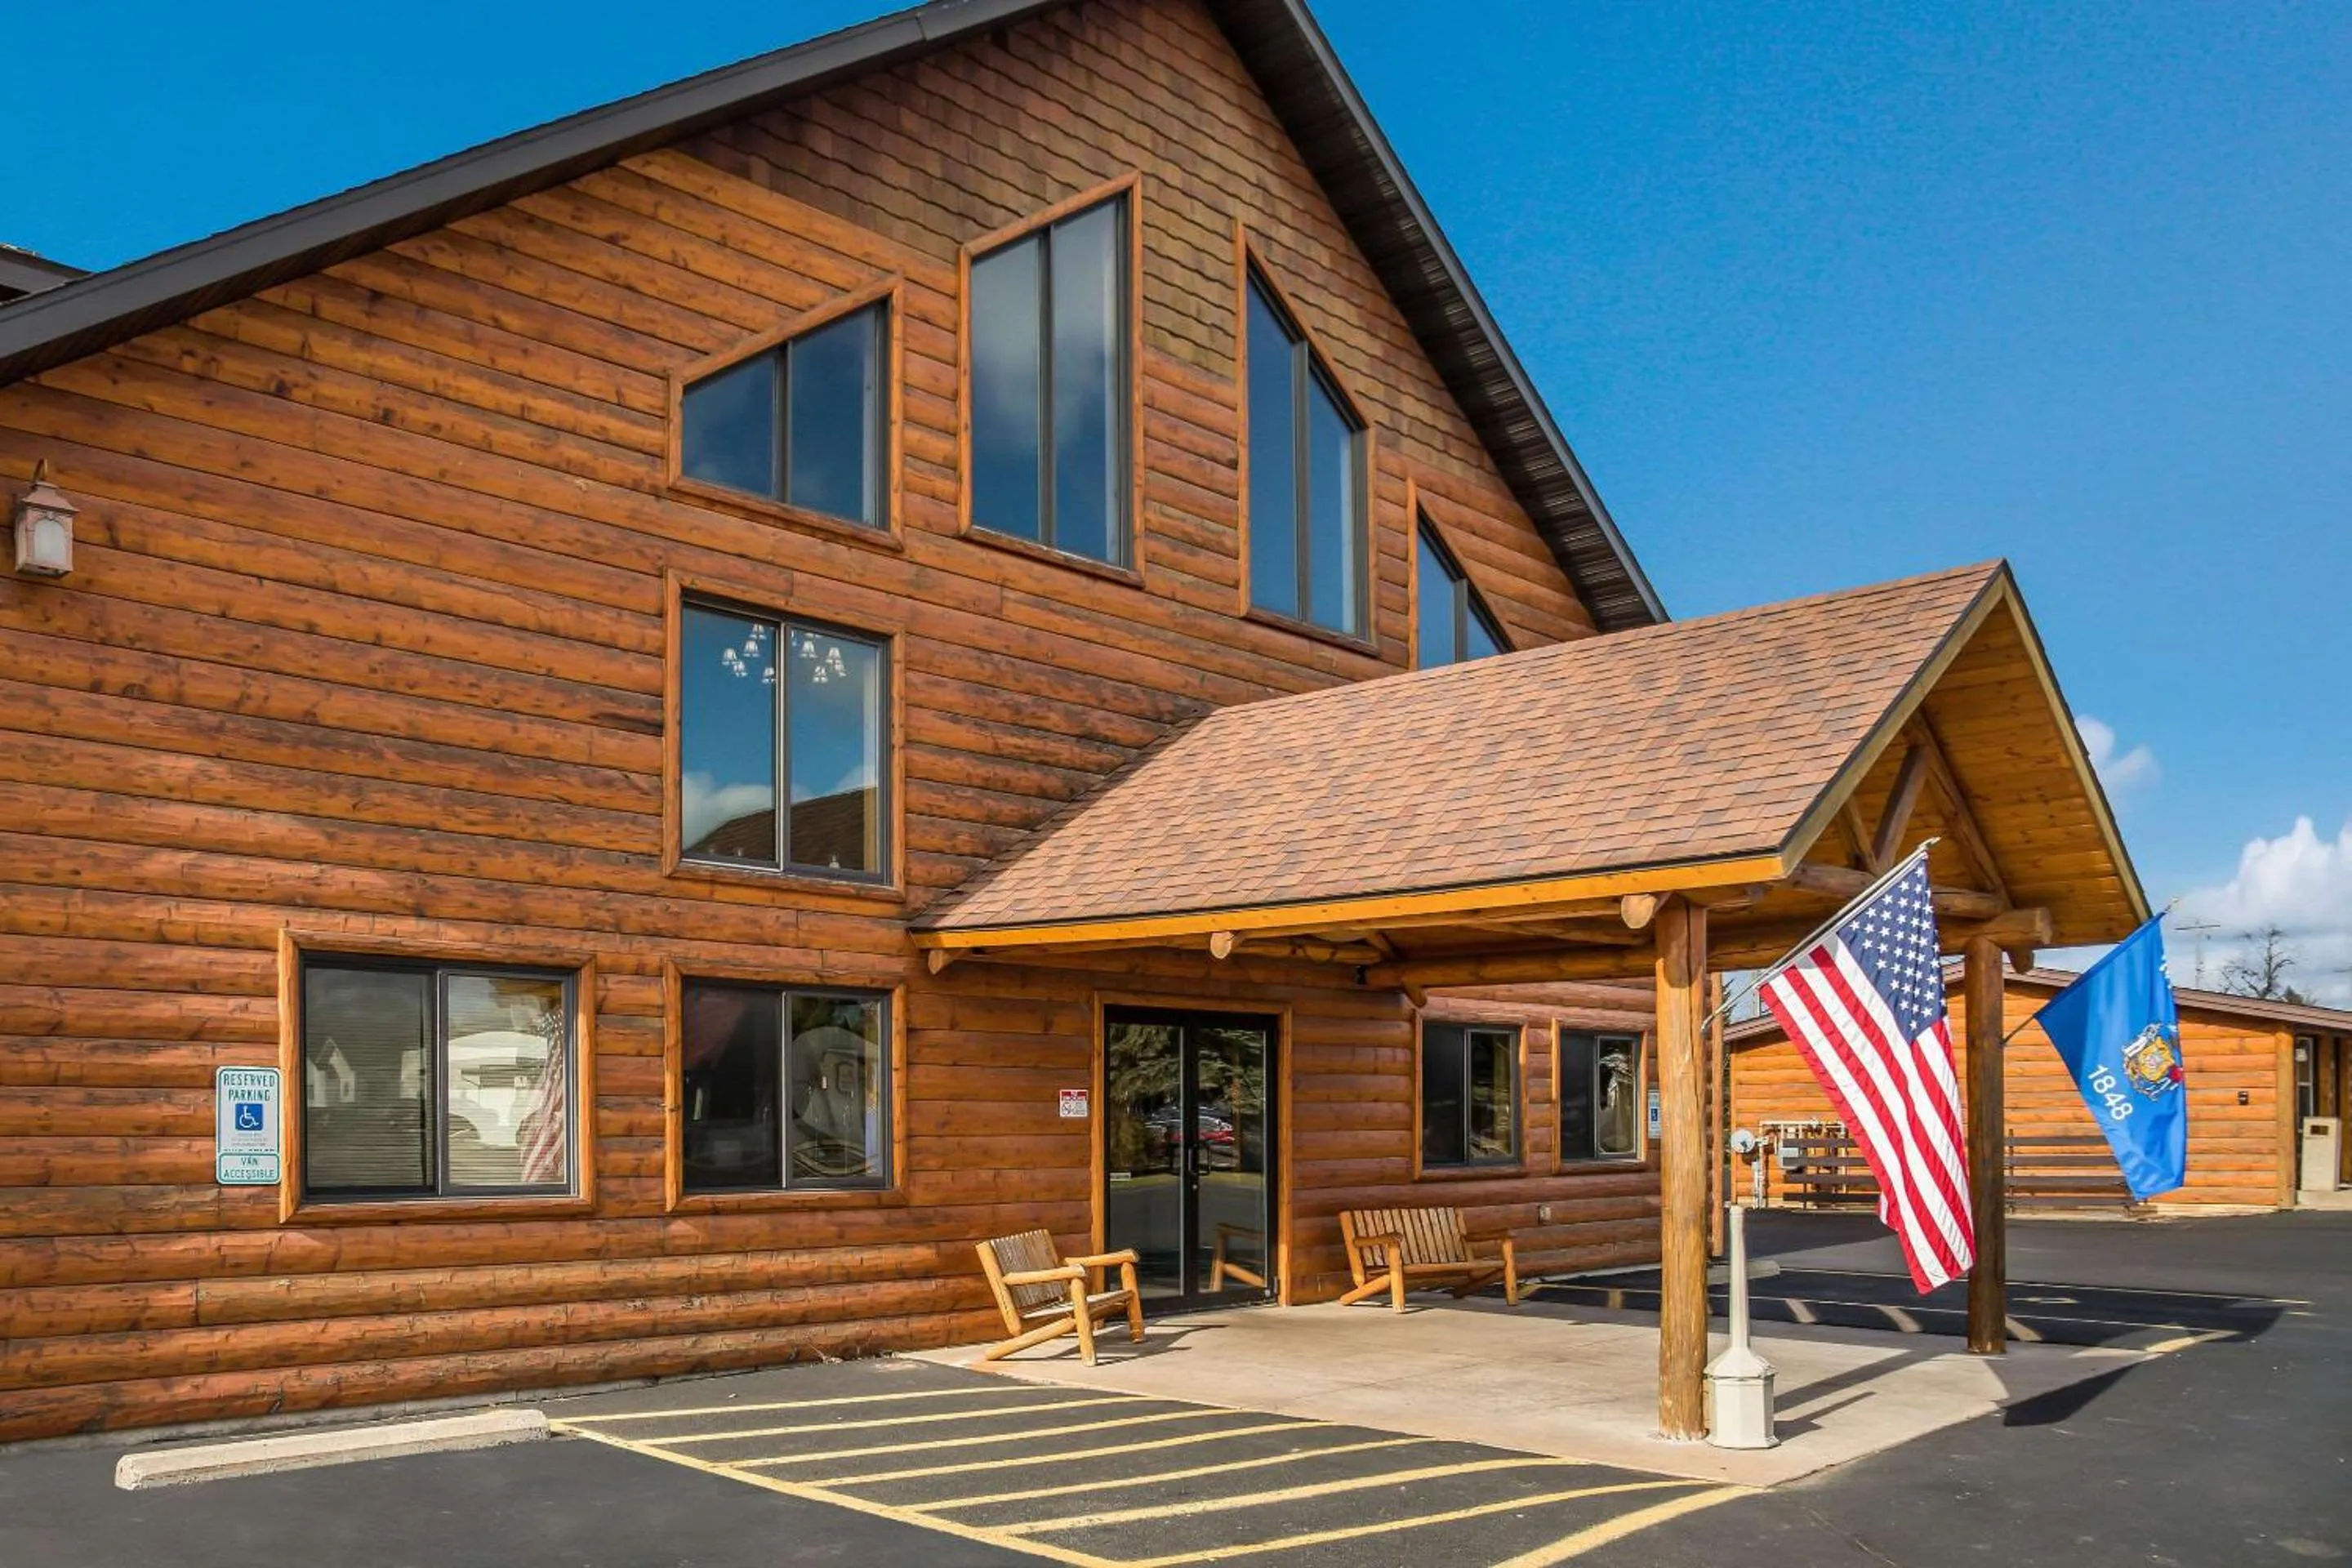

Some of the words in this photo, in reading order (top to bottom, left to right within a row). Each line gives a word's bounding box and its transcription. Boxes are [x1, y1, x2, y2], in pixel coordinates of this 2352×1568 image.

[223, 1073, 275, 1087] RESERVED
[228, 1089, 270, 1102] PARKING
[2087, 1065, 2133, 1120] 1848
[240, 1156, 258, 1166] VAN
[223, 1169, 275, 1179] ACCESSIBLE
